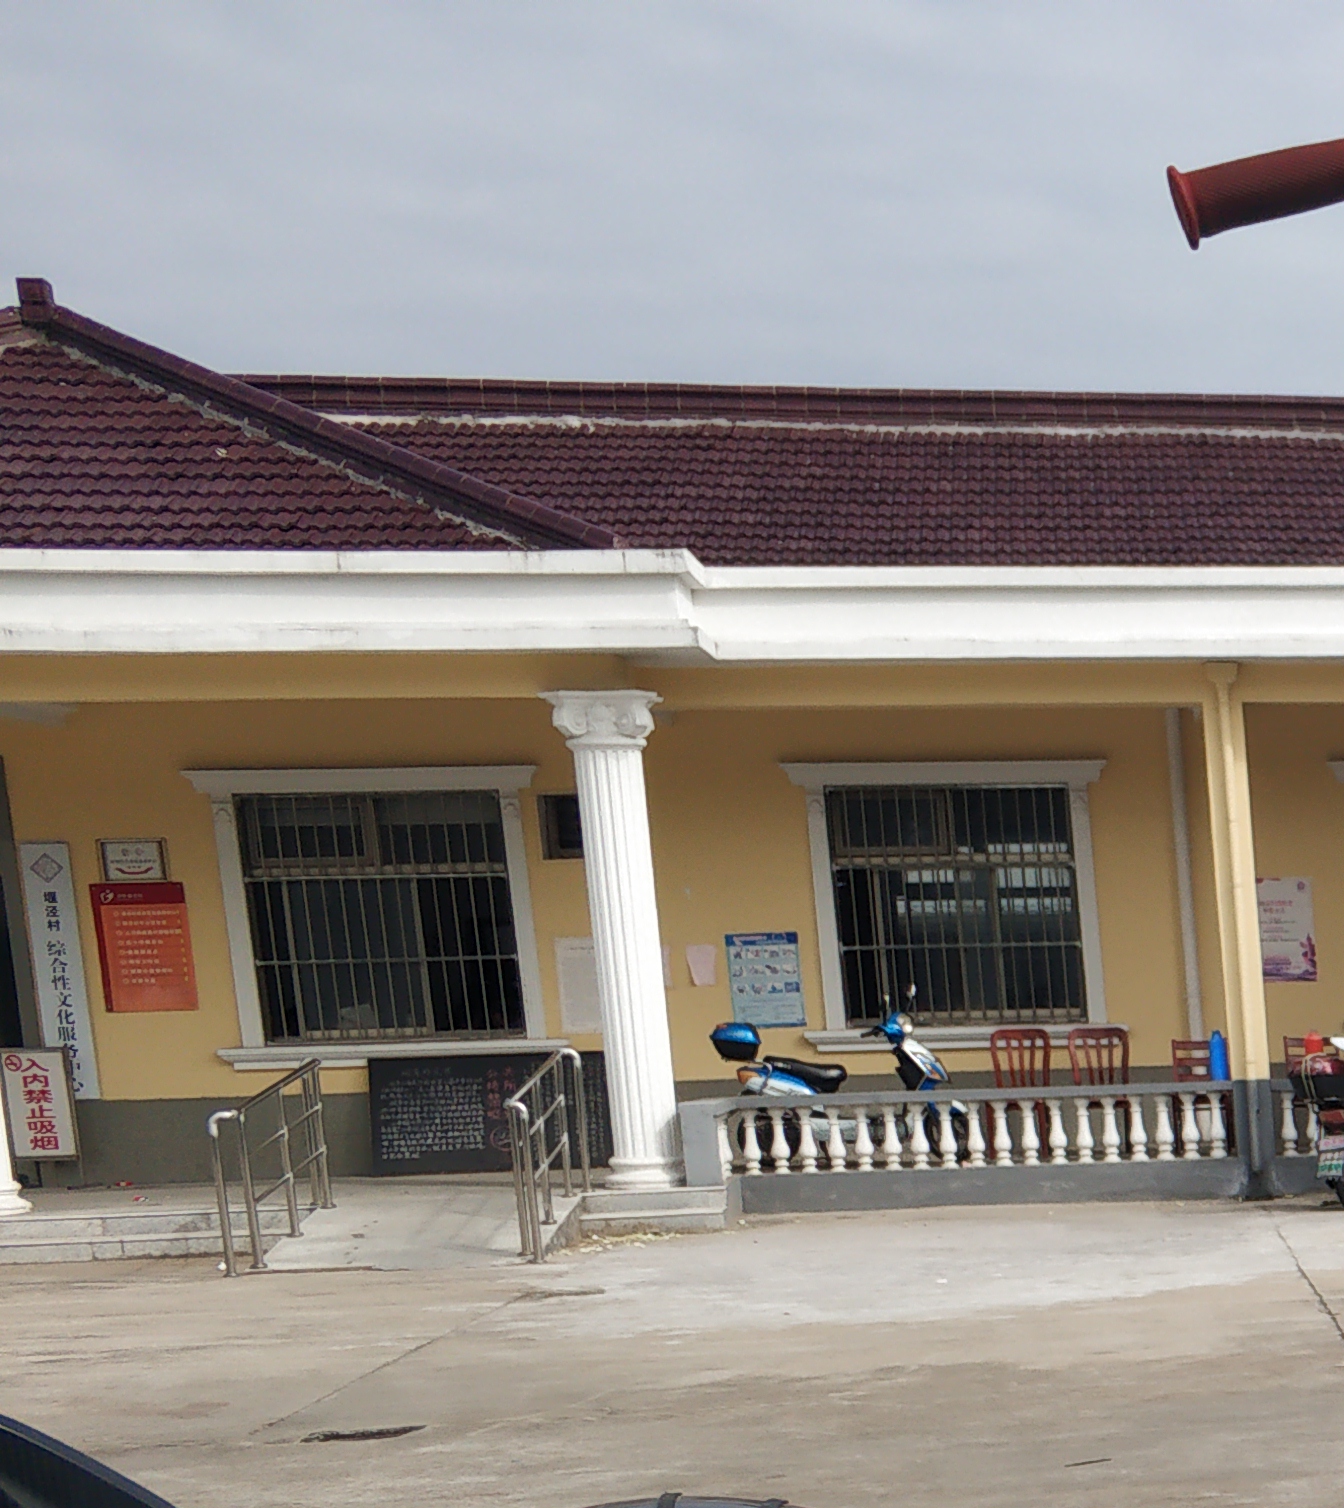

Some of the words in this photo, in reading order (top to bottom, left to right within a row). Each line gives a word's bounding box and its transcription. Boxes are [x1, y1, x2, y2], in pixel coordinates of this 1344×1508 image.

[21, 1058, 60, 1150] 入内禁止吸烟
